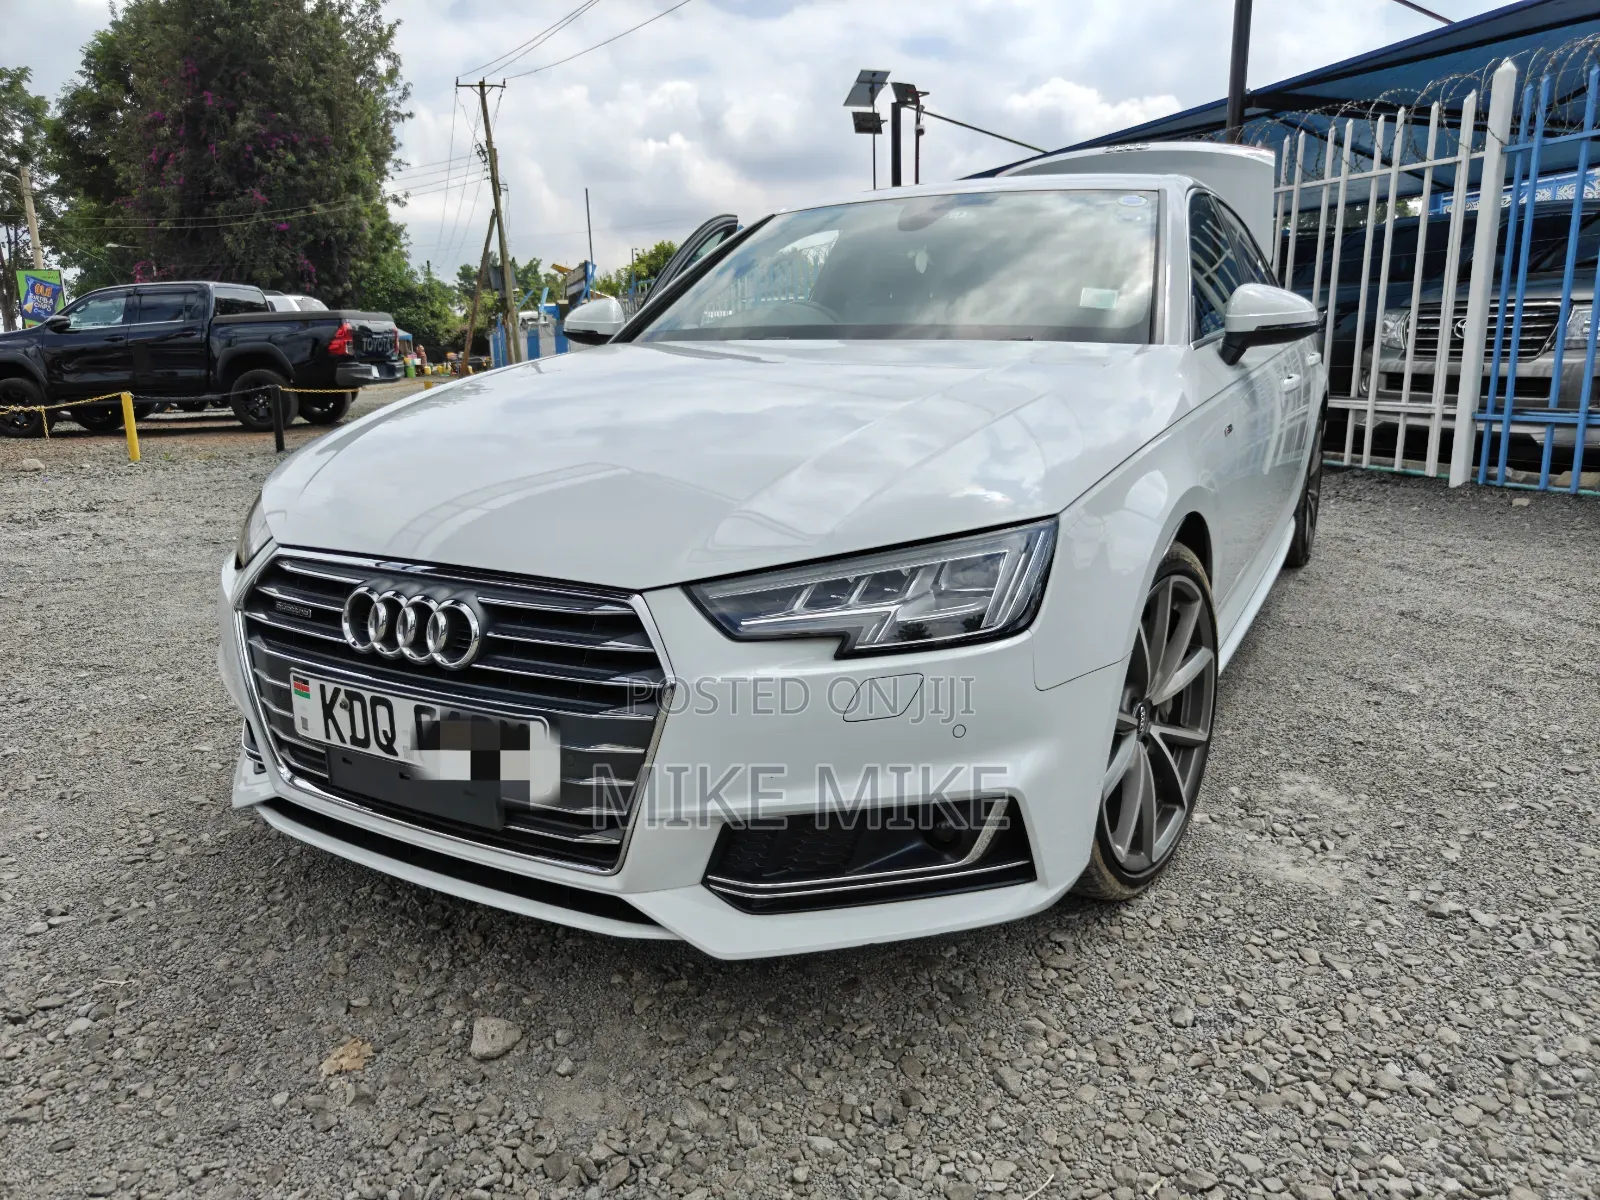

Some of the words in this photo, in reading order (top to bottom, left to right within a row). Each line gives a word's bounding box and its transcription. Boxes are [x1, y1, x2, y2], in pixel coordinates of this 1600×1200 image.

[35, 283, 52, 297] OLA
[362, 337, 391, 352] TOYOTA
[319, 683, 399, 757] KDQ
